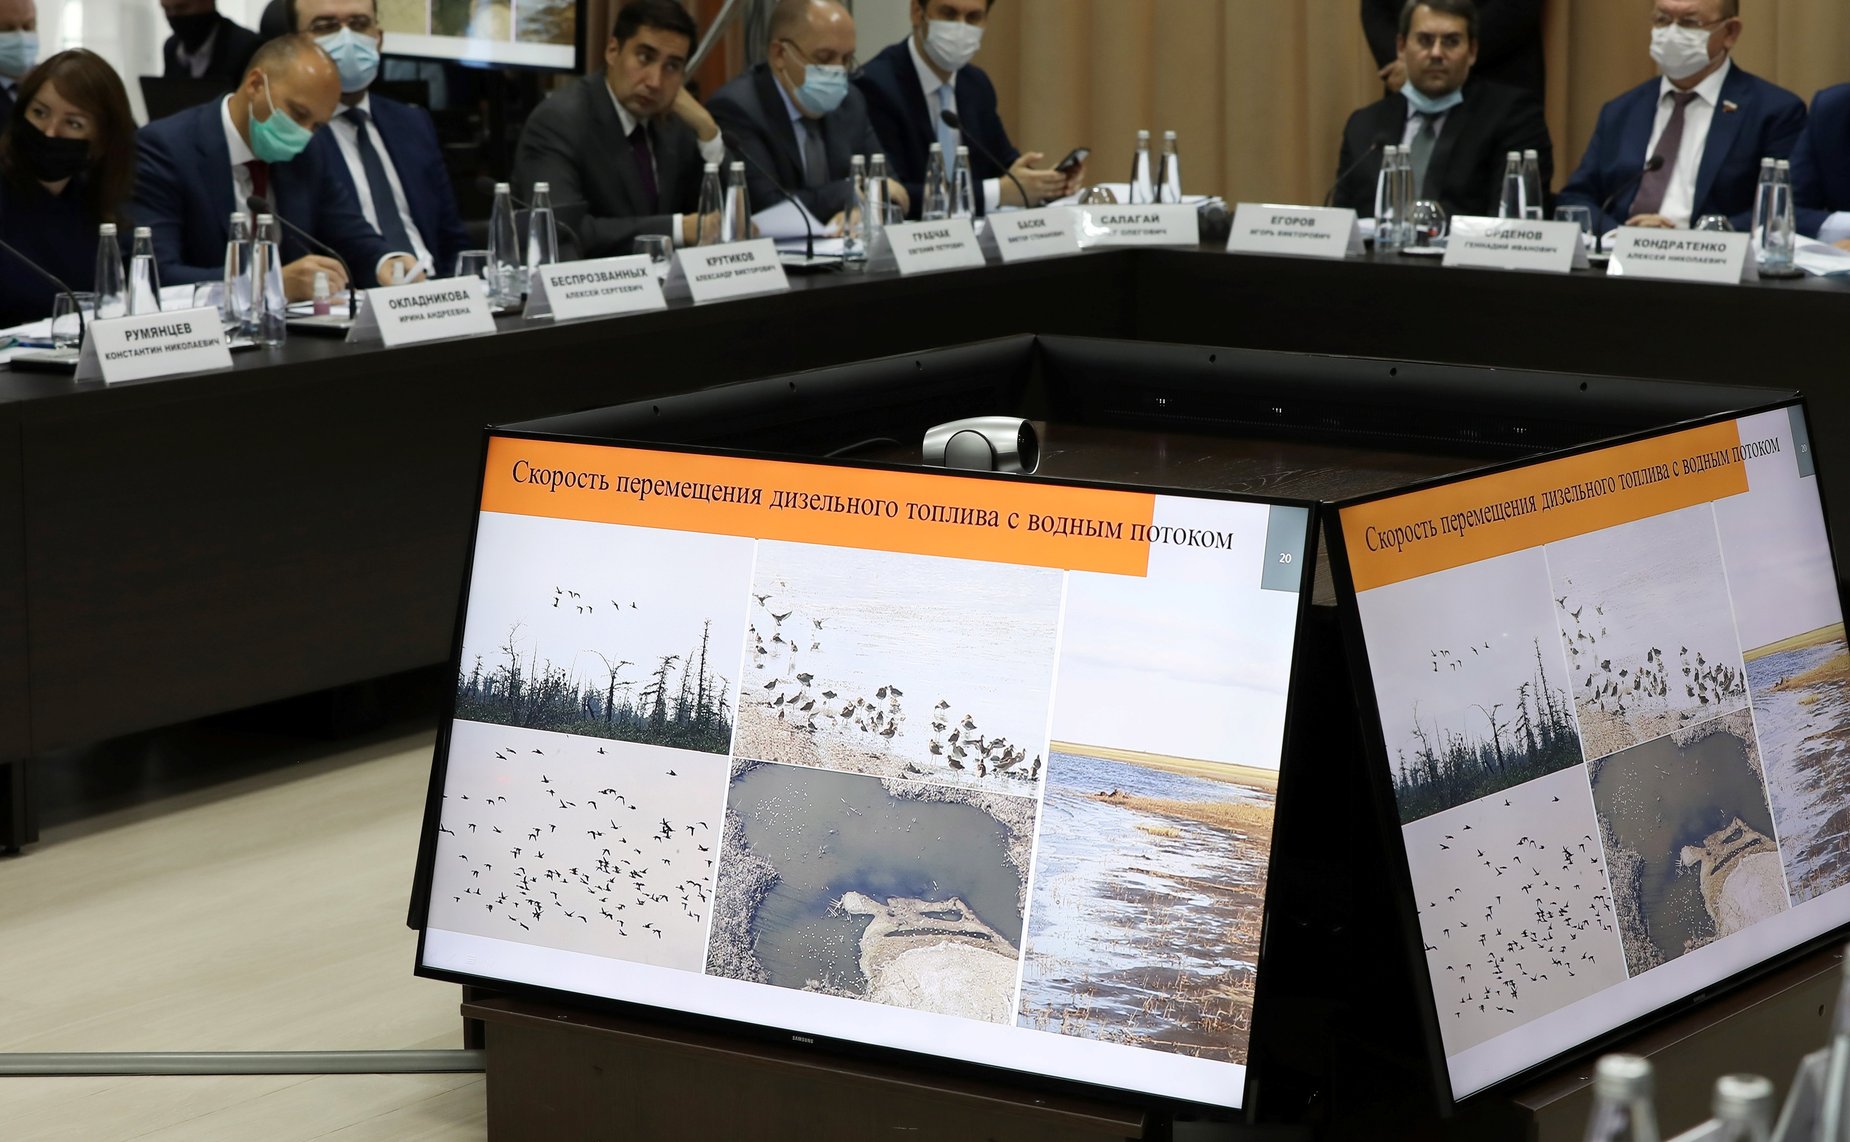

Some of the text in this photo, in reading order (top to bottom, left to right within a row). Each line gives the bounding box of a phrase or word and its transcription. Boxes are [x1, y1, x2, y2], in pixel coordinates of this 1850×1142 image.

[1101, 213, 1160, 225] САЛАГАЙ
[1271, 215, 1315, 227] ЕГОРОВ
[912, 229, 951, 241] ГРАБЧАК
[1277, 231, 1330, 239] ВИКТОРОВИЧ
[1464, 241, 1557, 253] ГЕННАДИЙ ИВАНОВИЧ
[1633, 238, 1727, 252] КОНДРАТЕНКО
[706, 252, 755, 266] КРУТИКОВ
[1627, 252, 1727, 264] АЛЕКСЕЙ НИКОЛАЕВИЧ
[550, 267, 648, 287] БЕСПРОЗВАННЫХ
[695, 264, 776, 282] АЛЕКСАНДР ВИКТОРОВИЧ
[565, 284, 644, 300] АЛЕКСЕЙ СЕРГЕЕВИЧ
[388, 290, 470, 309] ОКЛАДНИКОВА
[399, 307, 471, 322] ИРИНА АНДРЕЕВНА
[125, 322, 192, 341] РУМЯНЦЕВ
[105, 338, 220, 360] КОНСТАНТИН НИКОЛАЕВИЧ
[1800, 443, 1808, 453] 20
[1365, 436, 1781, 553] Скорость перемещения дизельного топлива с водным потоком
[512, 459, 1234, 550] Скорость перемещения дизельного топлива с водным потоком
[1278, 552, 1292, 564] 20
[792, 1035, 814, 1043] SAMSUNG
